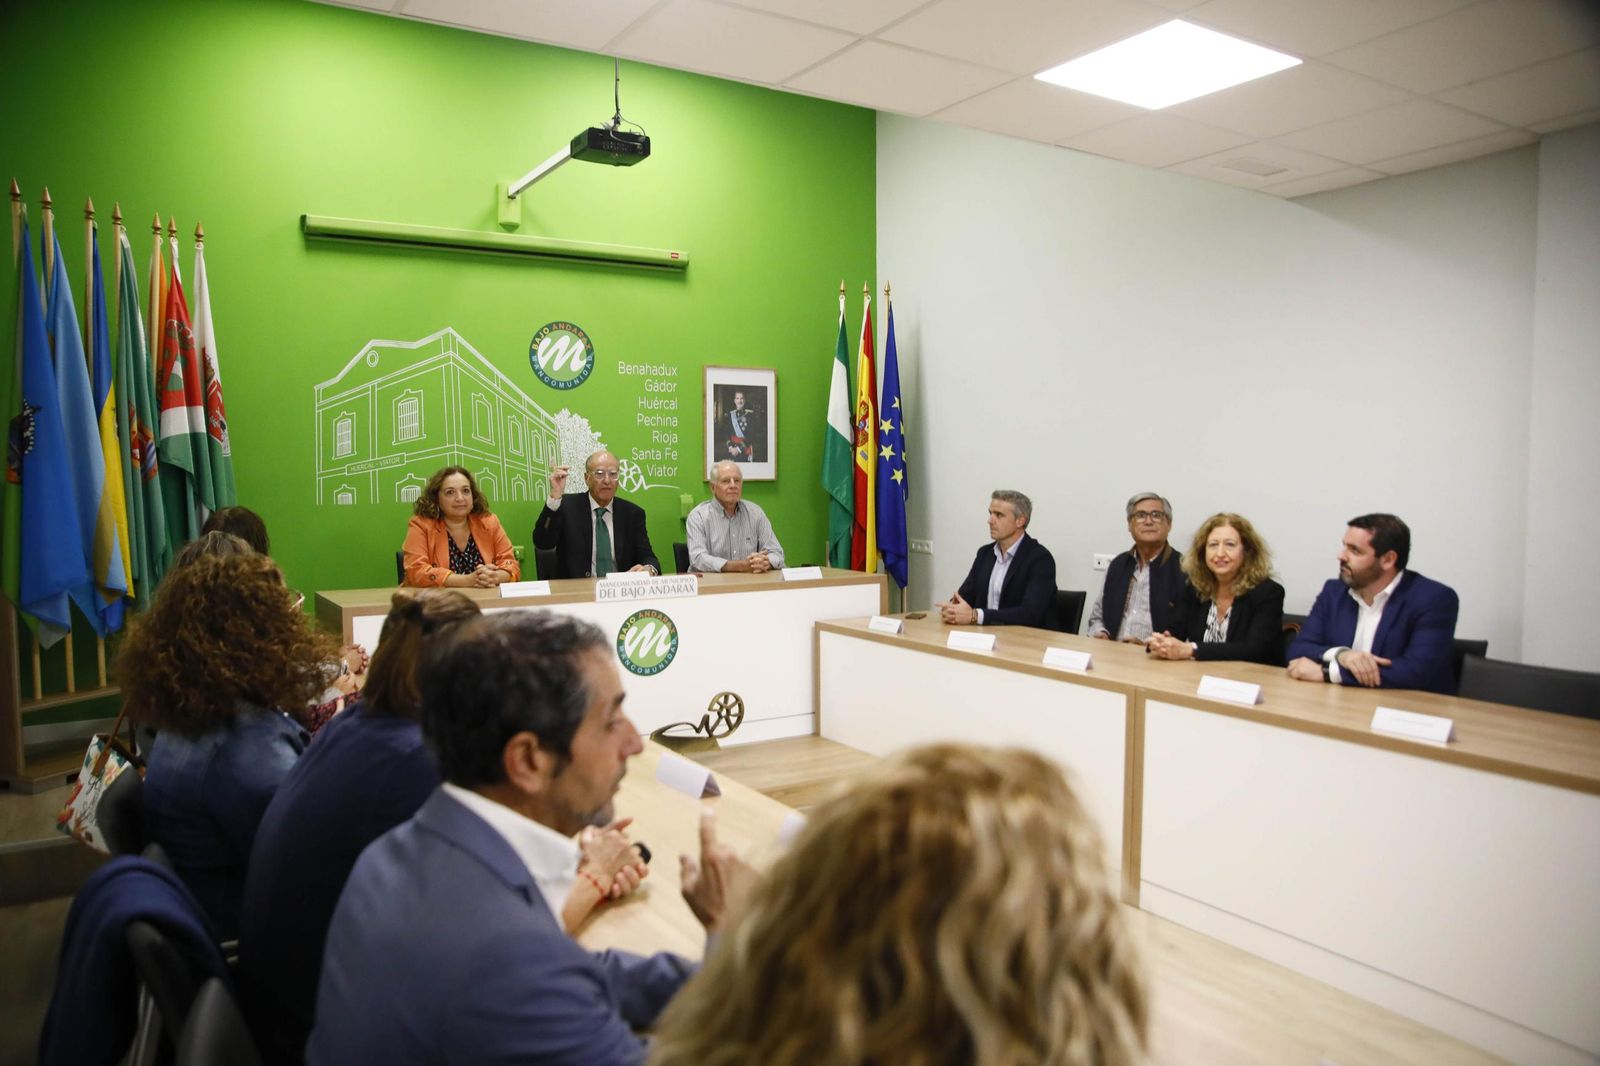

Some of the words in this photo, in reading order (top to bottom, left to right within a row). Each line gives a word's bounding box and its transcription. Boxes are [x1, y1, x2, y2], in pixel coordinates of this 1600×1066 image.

[532, 327, 549, 350] BAJO
[552, 323, 591, 350] ANDARAX
[531, 355, 593, 388] MANCOMUNIDAD
[618, 361, 678, 376] Benahadux
[644, 379, 677, 392] Gádor
[638, 396, 678, 409] Huércal
[637, 413, 678, 426] Pechina
[652, 430, 678, 445] Rioja
[631, 447, 661, 460] Santa
[664, 448, 678, 460] Fe
[646, 463, 678, 477] Viator
[599, 579, 650, 588] MANCOMUNIDAD
[599, 588, 617, 599] DEL
[620, 586, 646, 598] BAJO
[648, 583, 695, 595] ANDARAX
[619, 616, 636, 640] BAJO
[638, 611, 676, 633] ANDARAX
[619, 639, 678, 674] MANCOMUNIDAD
